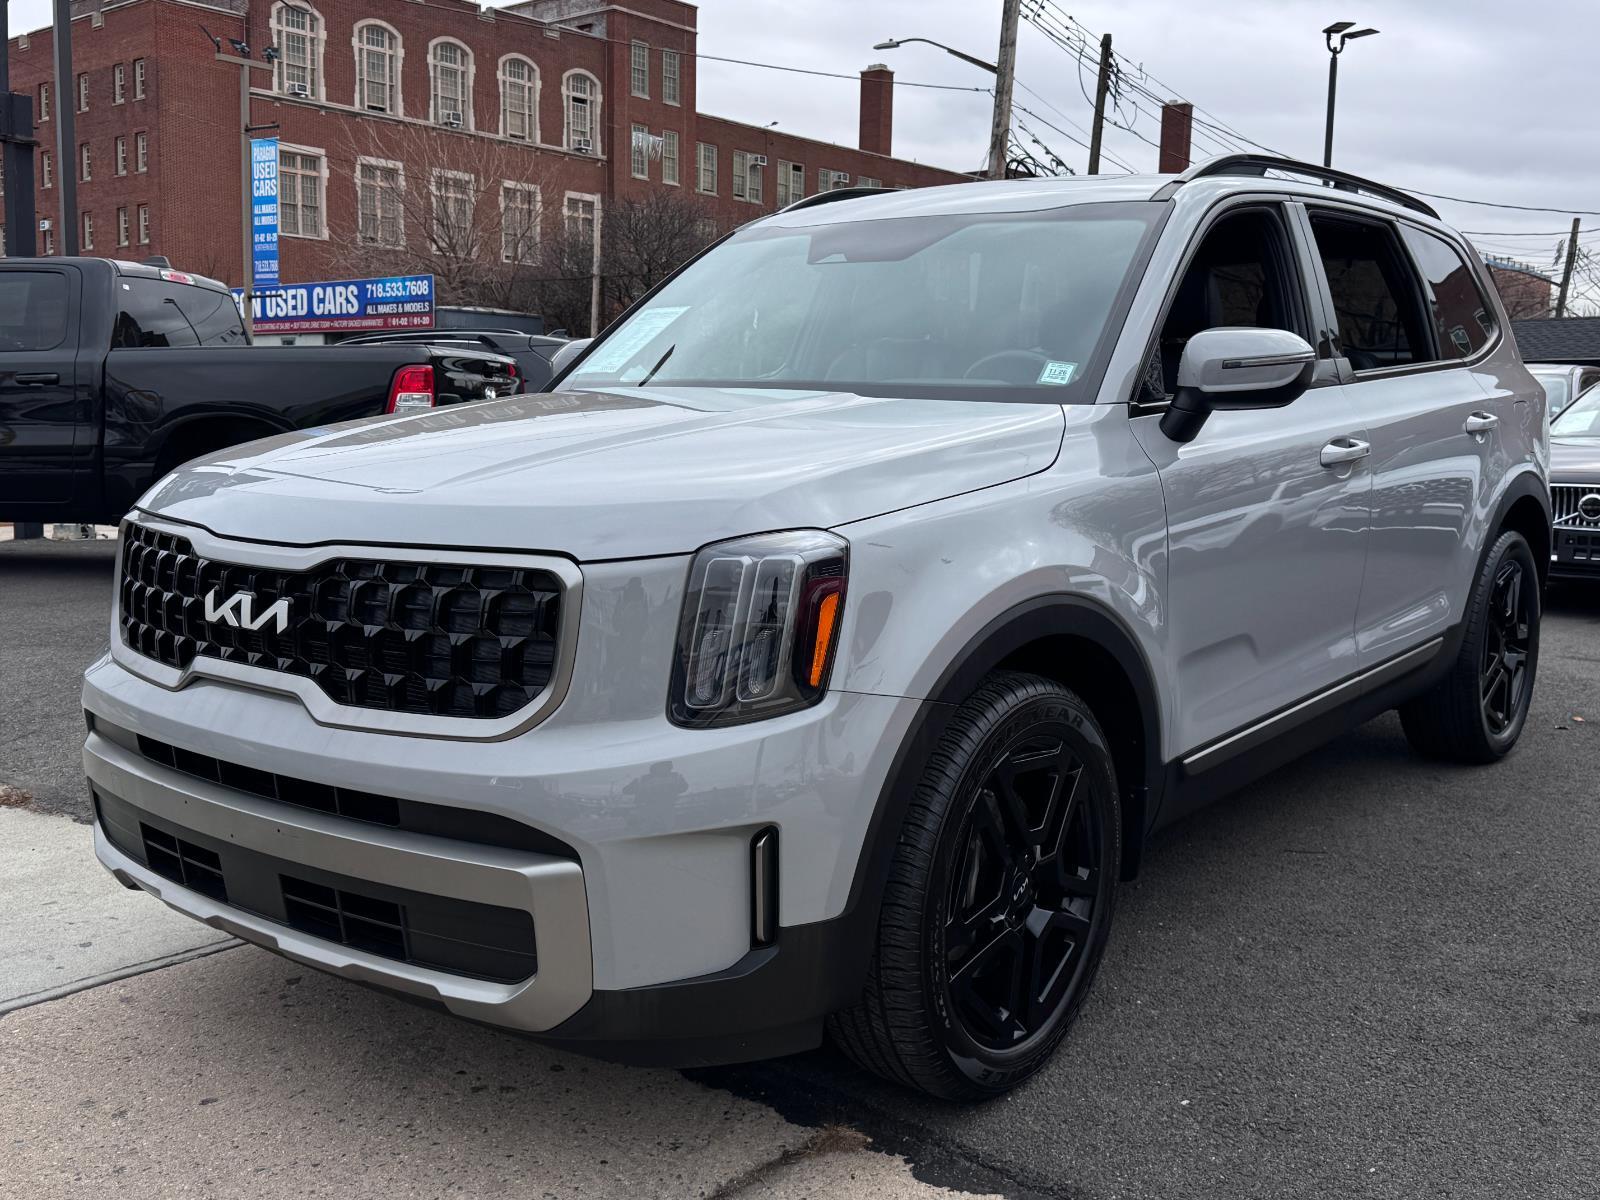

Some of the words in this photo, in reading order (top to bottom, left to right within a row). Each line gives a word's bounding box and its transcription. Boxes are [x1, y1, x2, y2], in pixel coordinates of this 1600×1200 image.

[254, 161, 276, 179] USED
[254, 179, 277, 197] CARS
[366, 280, 429, 298] 718.533.7608
[265, 288, 308, 318] USED
[313, 284, 359, 316] CARS
[367, 305, 377, 314] ALL
[378, 303, 397, 314] MAKES
[404, 302, 430, 312] MODELS
[204, 587, 289, 635] KIA
